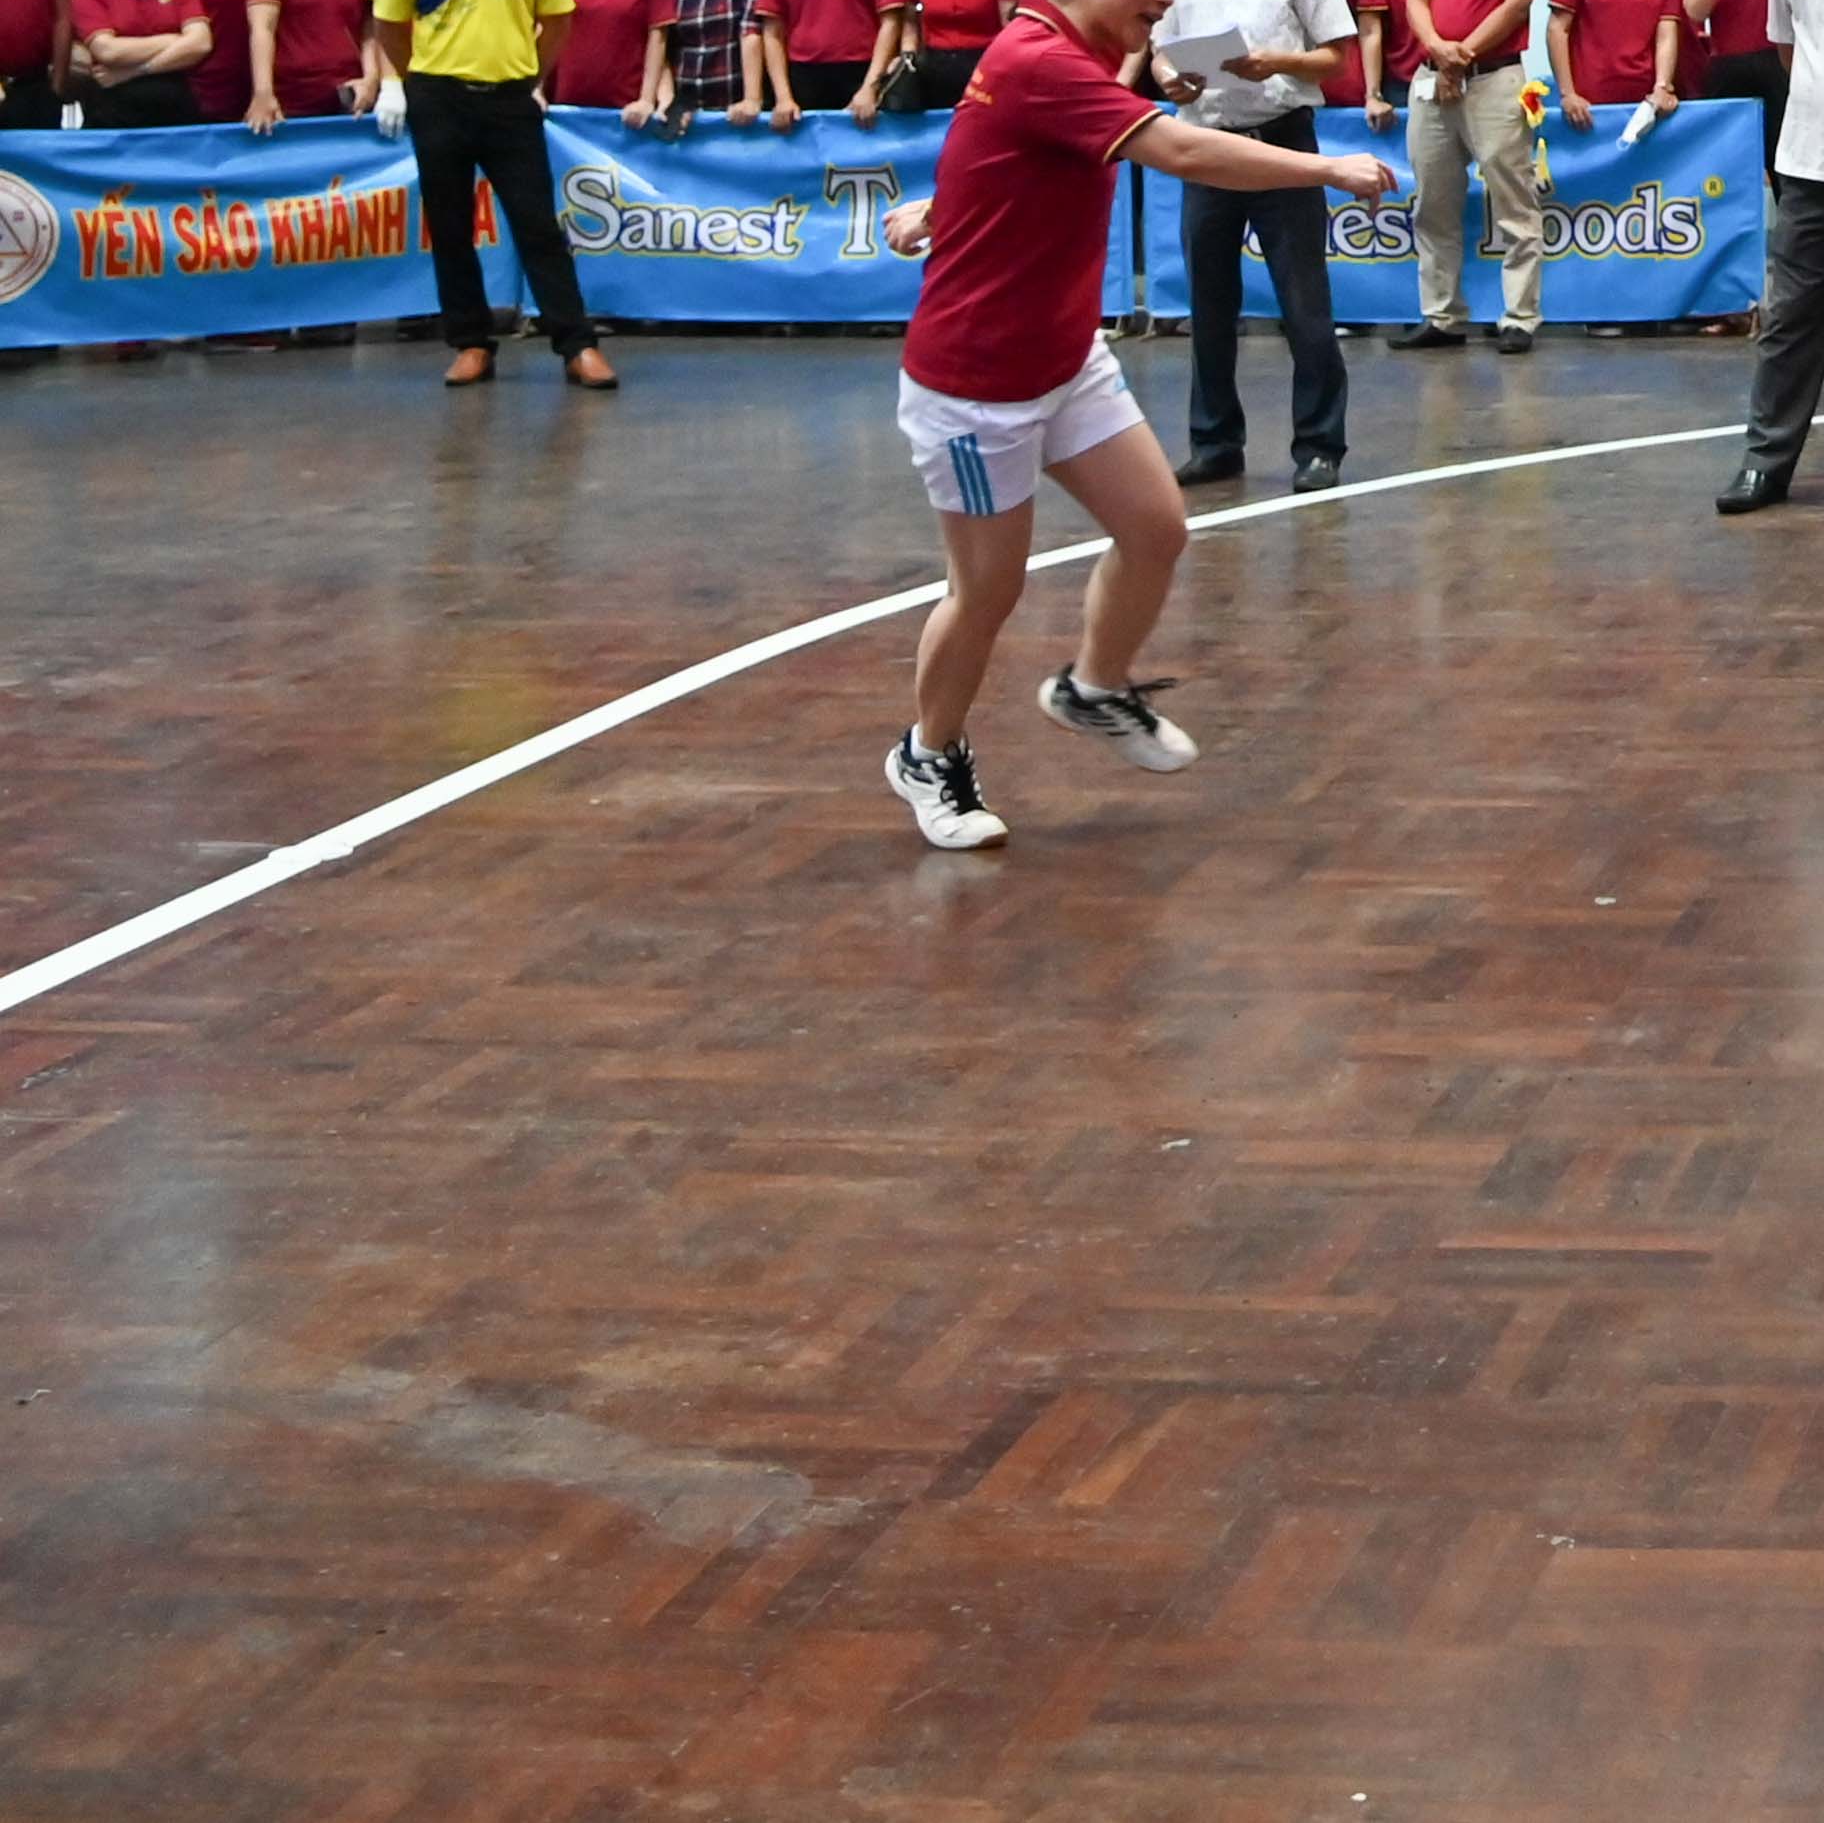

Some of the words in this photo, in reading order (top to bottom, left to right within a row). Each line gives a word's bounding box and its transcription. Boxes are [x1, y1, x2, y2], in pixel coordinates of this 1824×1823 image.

[74, 184, 163, 278] YẾN
[172, 186, 259, 273] SÀO
[265, 175, 408, 265] KHÁNH
[563, 166, 804, 257] Sanest
